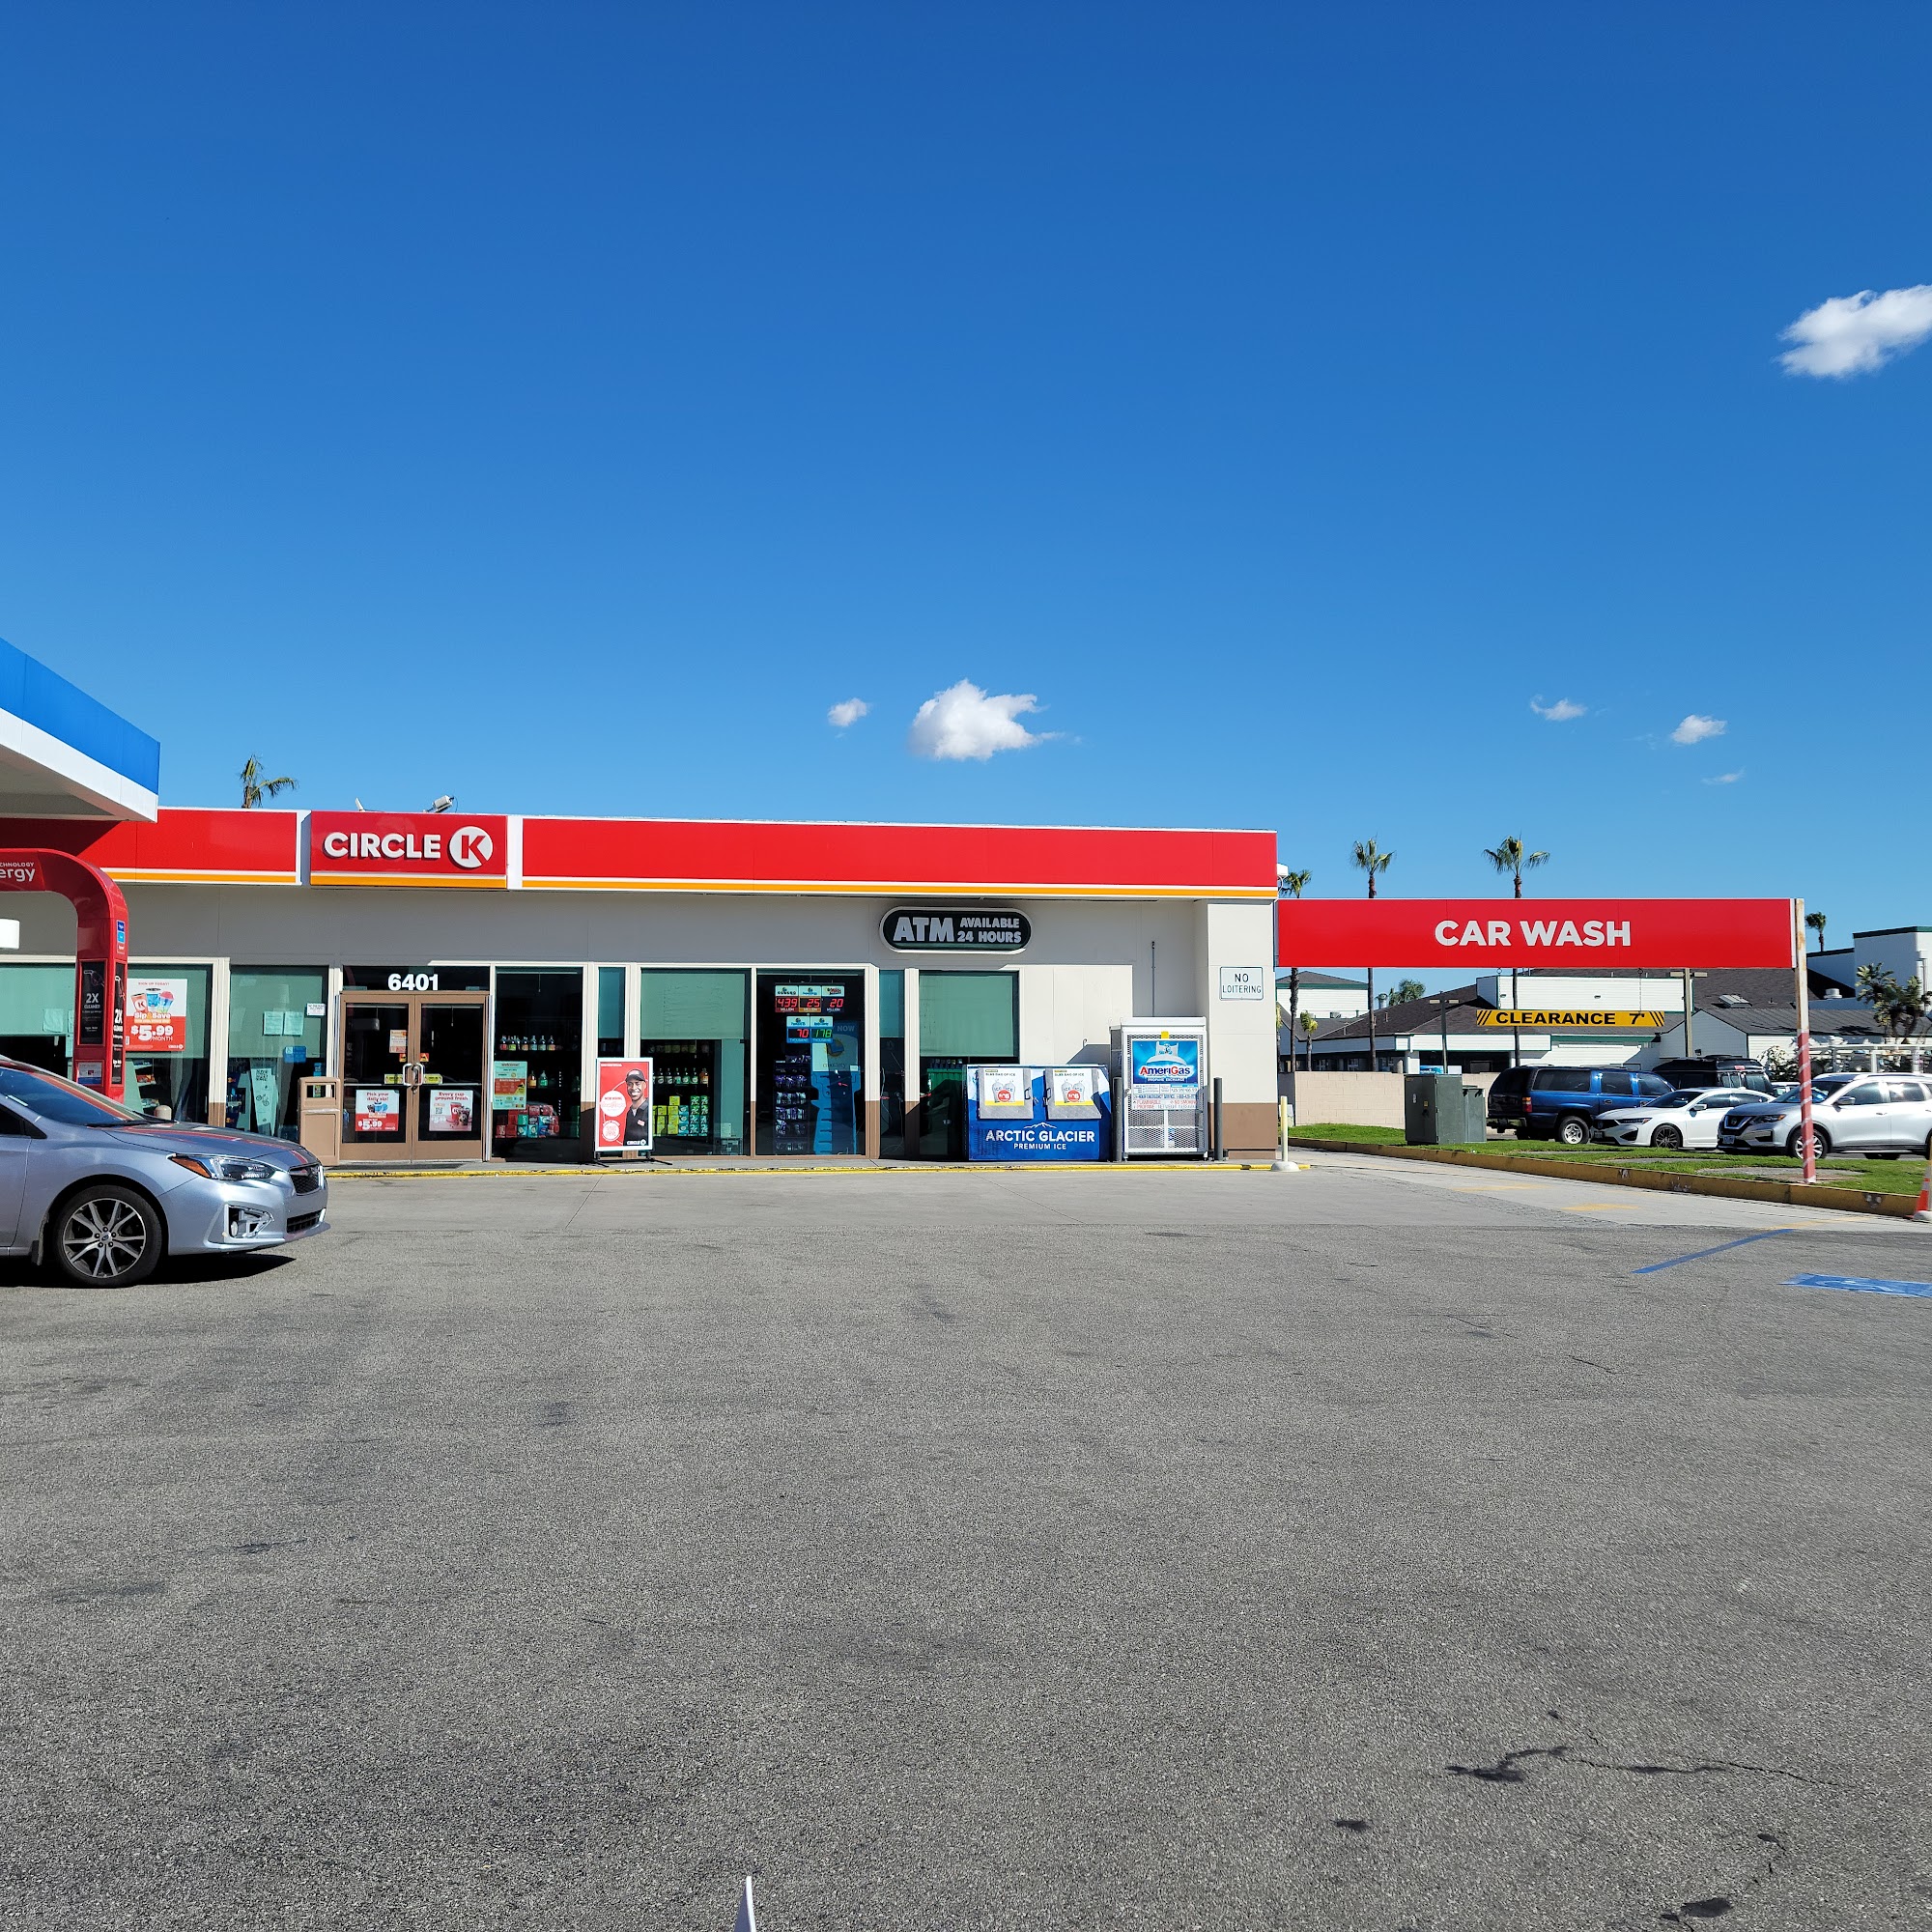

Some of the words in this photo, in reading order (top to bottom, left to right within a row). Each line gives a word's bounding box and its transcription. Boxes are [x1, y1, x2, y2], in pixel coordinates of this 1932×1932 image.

[324, 832, 440, 860] CIRCLE
[960, 918, 1019, 928] AVAILABLE
[893, 917, 955, 942] ATM
[1435, 921, 1512, 947] CAR
[1520, 921, 1631, 947] WASH
[957, 931, 974, 943] 24
[979, 931, 1022, 943] HOURS
[387, 973, 439, 991] 6401
[1235, 973, 1249, 982] NO
[1222, 984, 1262, 993] LOITERING
[86, 993, 99, 1004] 2X
[778, 998, 798, 1008] 439
[807, 998, 820, 1007] 25
[830, 999, 843, 1008] 20
[115, 1009, 123, 1024] 2X
[1495, 1012, 1615, 1025] CLEARANCE
[130, 1025, 173, 1041] $5.99
[797, 1029, 810, 1037] 70
[1140, 1065, 1191, 1075] AmeriGas
[985, 1130, 1035, 1142] ARCTIC
[1038, 1130, 1095, 1142] GLACIER
